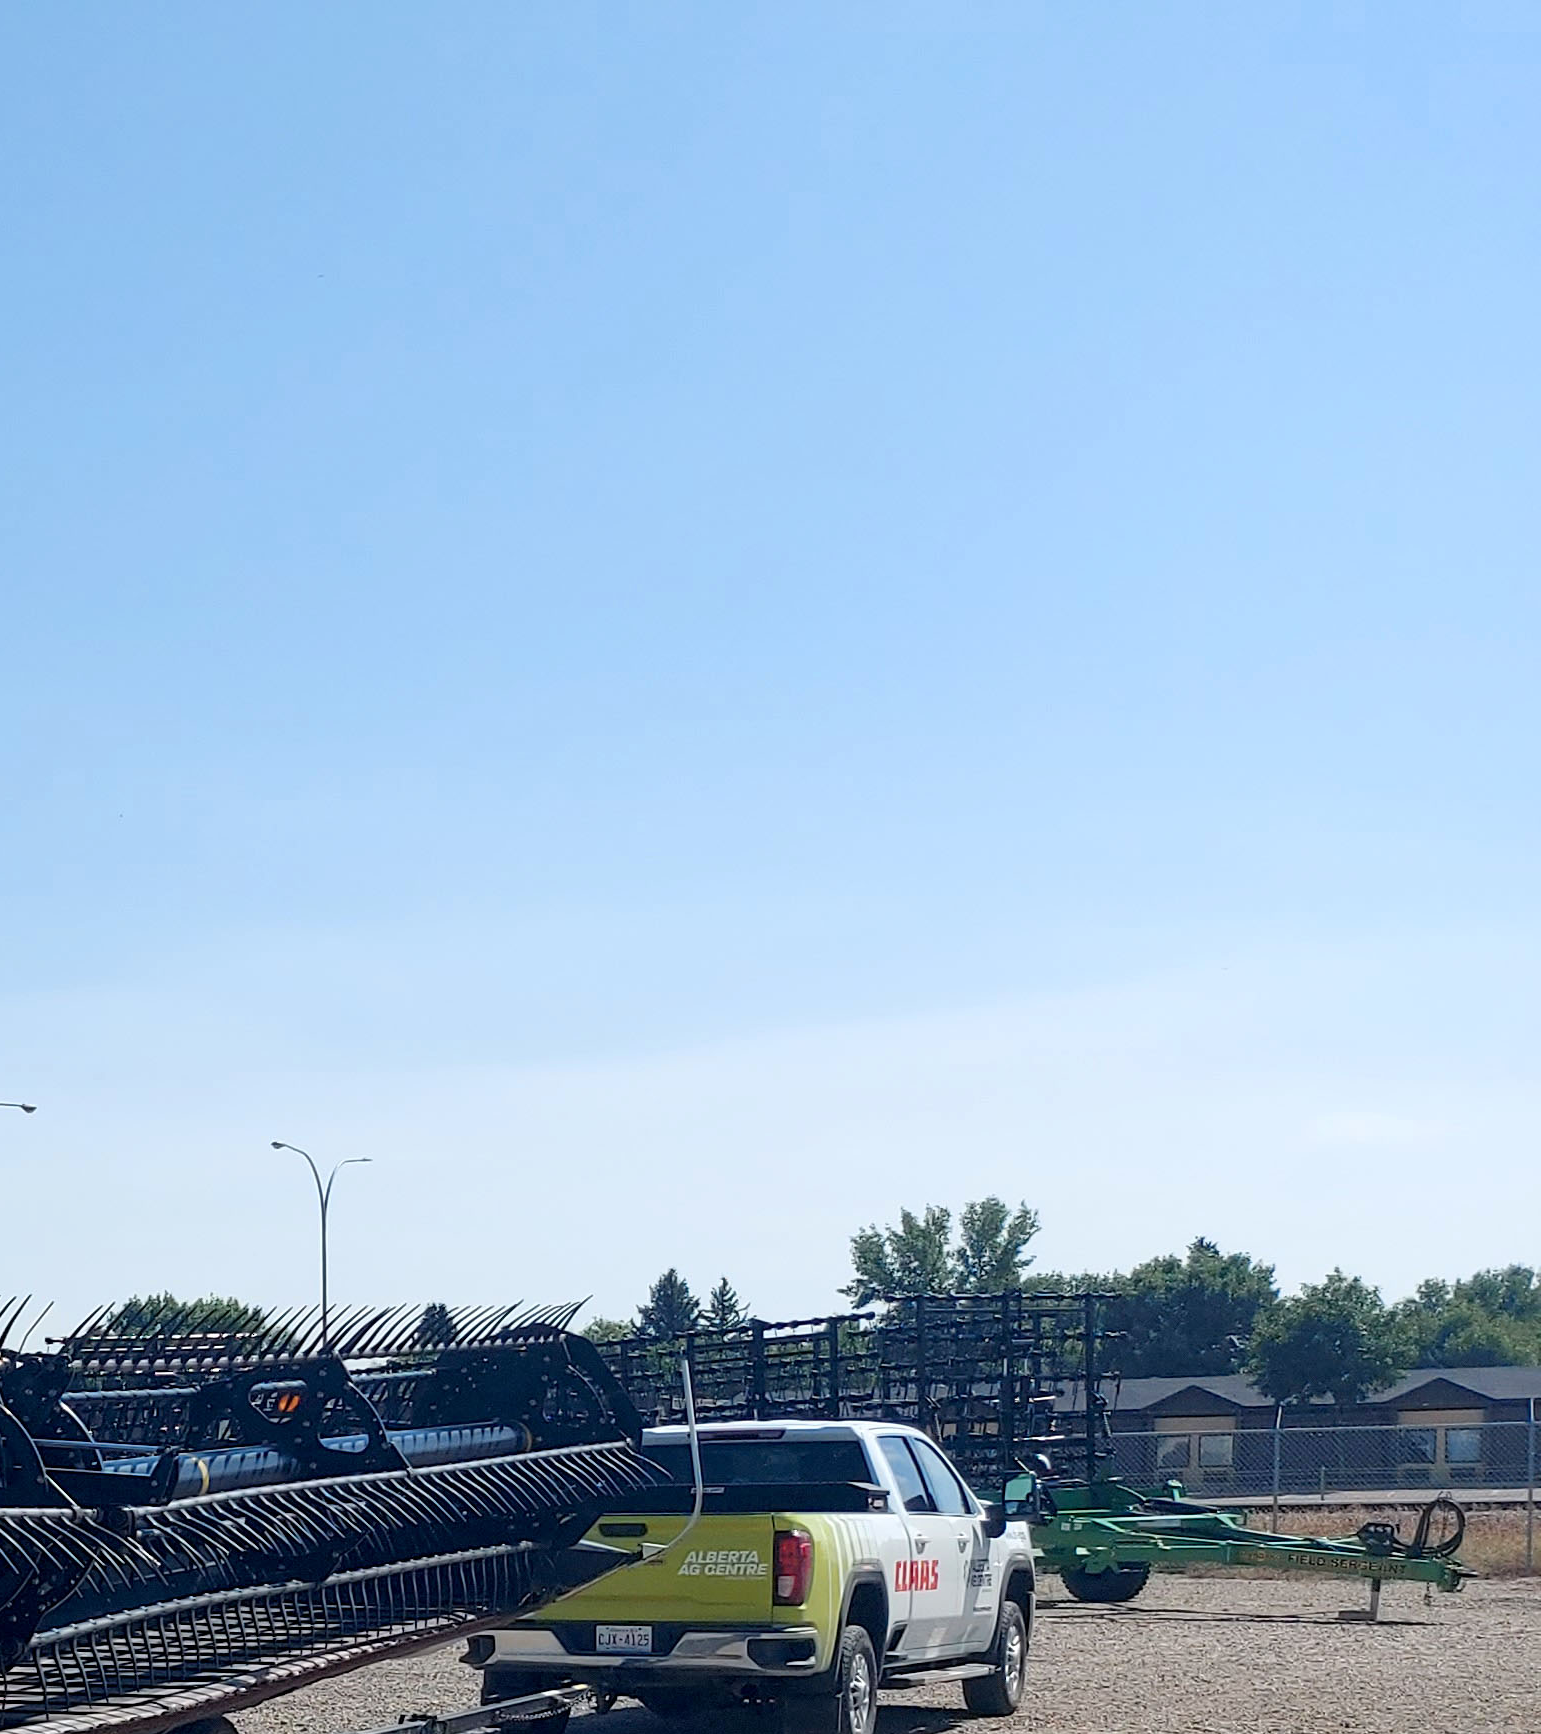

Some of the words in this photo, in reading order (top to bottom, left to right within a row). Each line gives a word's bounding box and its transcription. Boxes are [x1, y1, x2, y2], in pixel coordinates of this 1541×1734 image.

[684, 1551, 760, 1564] ALBERTA
[1288, 1554, 1326, 1567] FIELD
[678, 1564, 701, 1576] AG
[704, 1564, 769, 1576] CENTRE
[894, 1559, 939, 1592] CLAAS
[598, 1632, 650, 1647] CJX-4125
